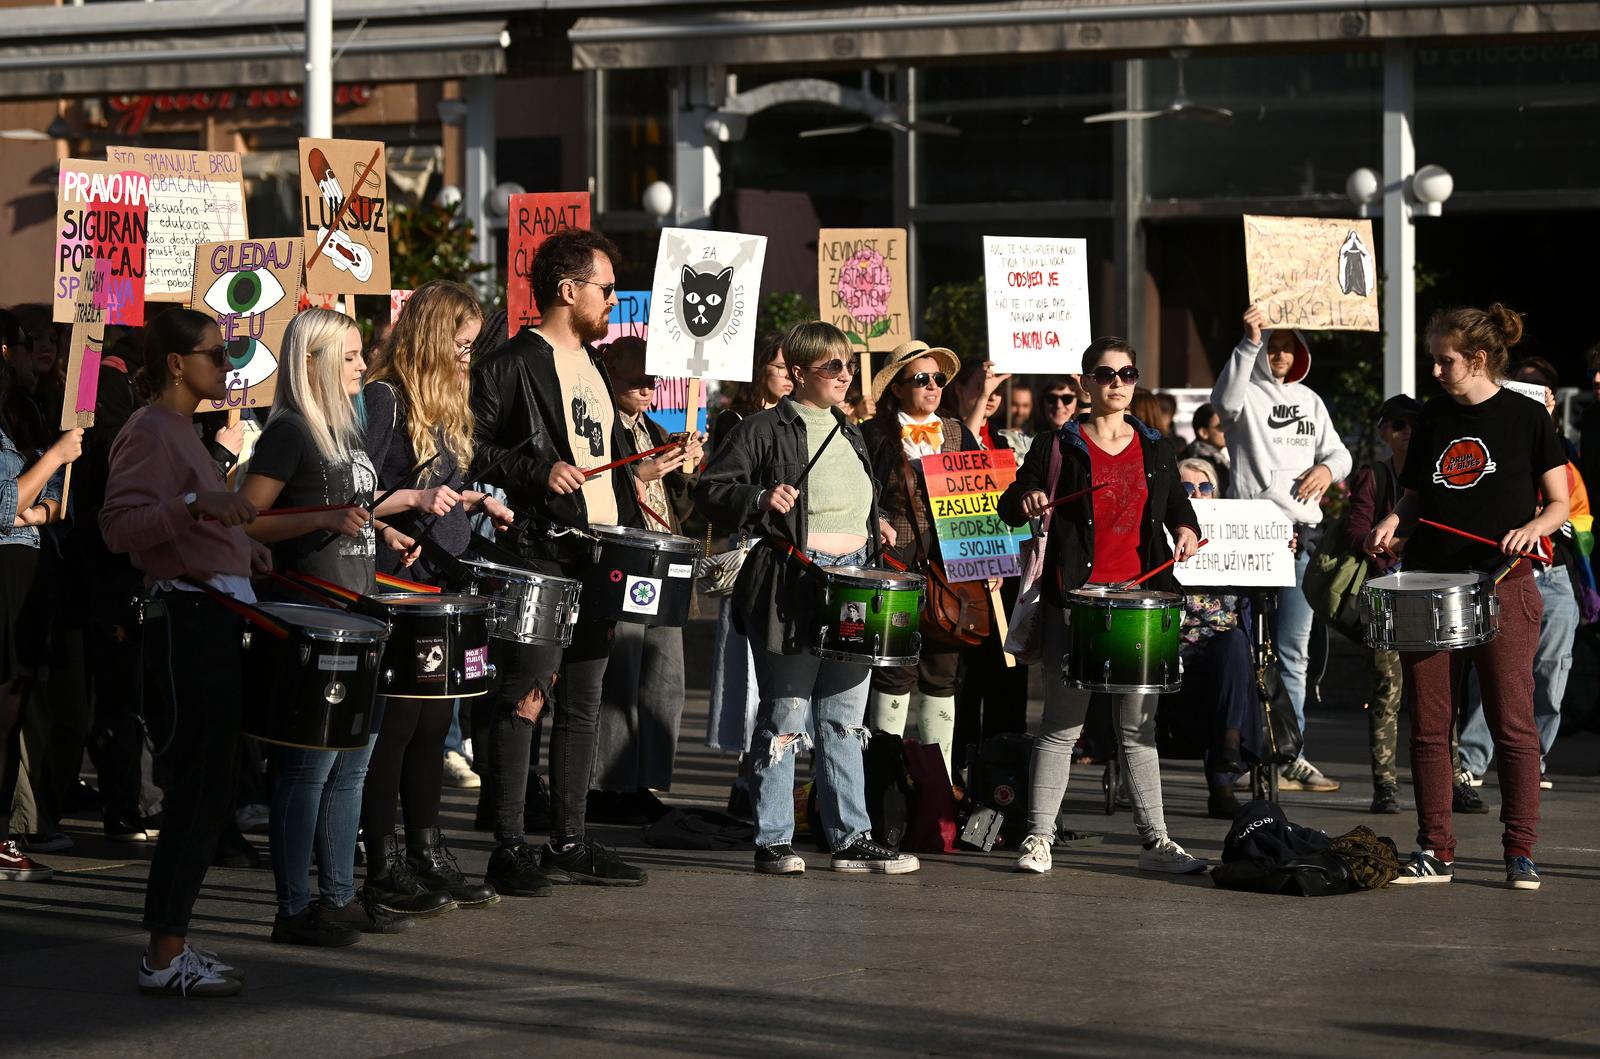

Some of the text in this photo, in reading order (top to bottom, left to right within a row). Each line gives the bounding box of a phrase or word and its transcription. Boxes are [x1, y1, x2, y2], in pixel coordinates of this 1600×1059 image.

[208, 153, 237, 173] BROJ
[64, 171, 149, 207] PRAVO NA
[149, 198, 199, 215] eksualna
[61, 210, 149, 244] SIGURAN
[160, 216, 210, 236] edukacija
[210, 241, 293, 275] GLEDAJ
[702, 246, 717, 260] ZA
[882, 239, 897, 261] JE
[1047, 271, 1060, 287] JE
[663, 287, 681, 343] USTANI
[722, 284, 745, 346] SLOBODU
[217, 311, 266, 342] ME U
[1045, 331, 1060, 348] GA
[1273, 405, 1300, 419] NIKE
[1296, 421, 1316, 436] AIR
[942, 453, 992, 472] QUEER
[946, 474, 997, 493] DJECA
[1254, 521, 1289, 541] KLEČITE
[960, 540, 1007, 557] SVOJIH
